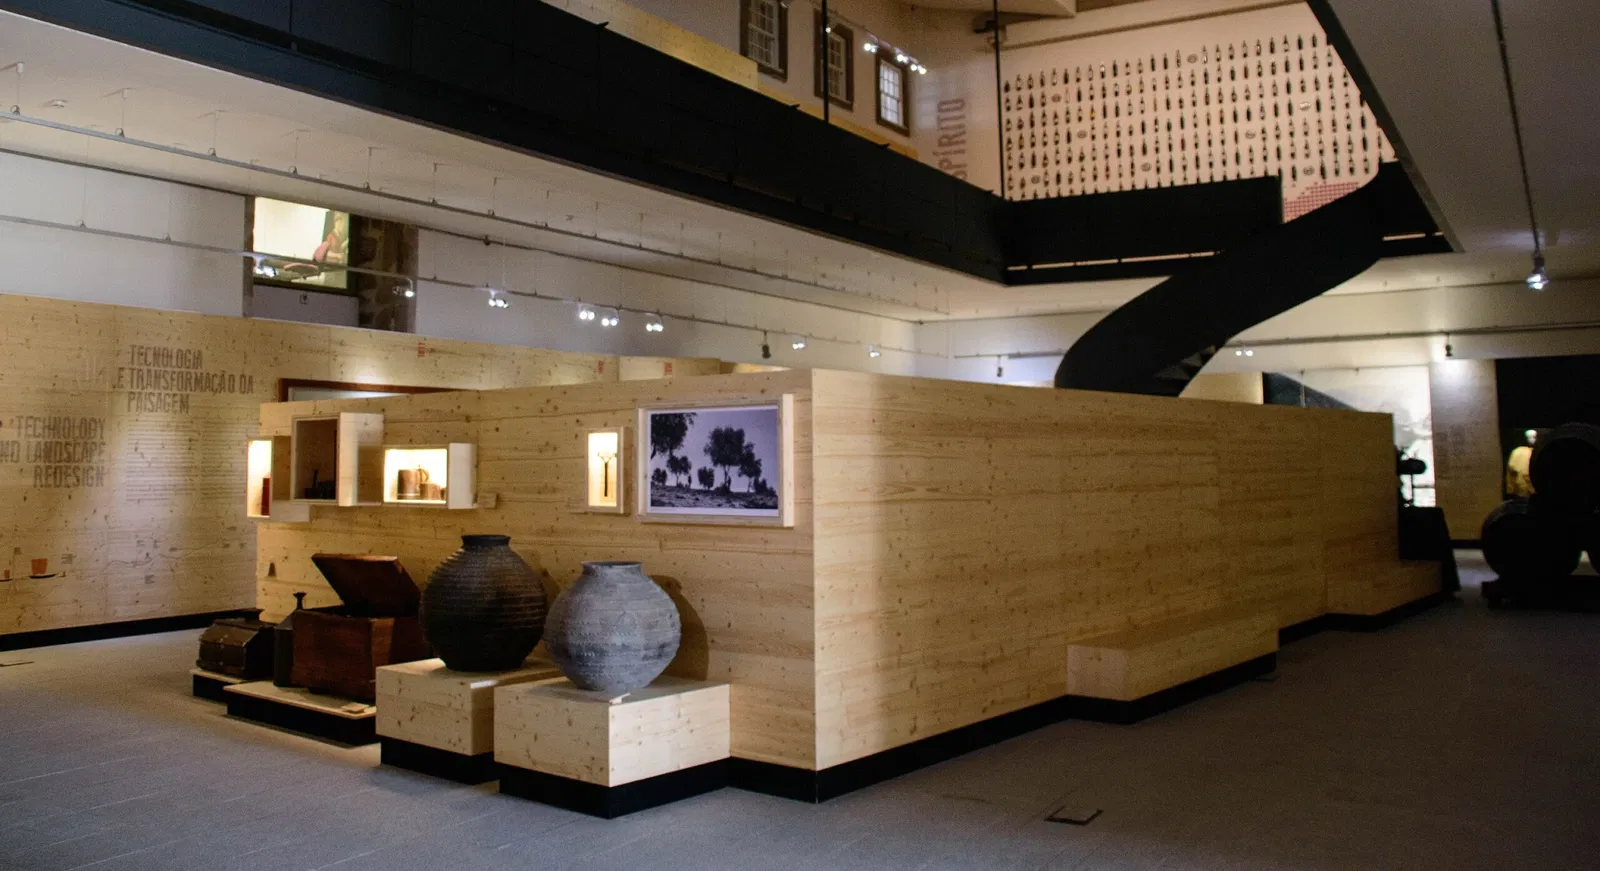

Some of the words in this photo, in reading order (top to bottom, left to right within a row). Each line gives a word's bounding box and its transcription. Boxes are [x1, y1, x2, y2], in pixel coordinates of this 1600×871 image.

[129, 344, 203, 370] TECNOLOGIA
[117, 367, 126, 389] E
[129, 367, 236, 397] TRANSFORMAÇÃO
[239, 373, 255, 395] DA
[127, 391, 190, 415] PAISAGEM
[15, 415, 106, 440] TECHNOLOGY
[26, 440, 106, 463] LANDSCAPE
[33, 464, 105, 488] REDESIGN
